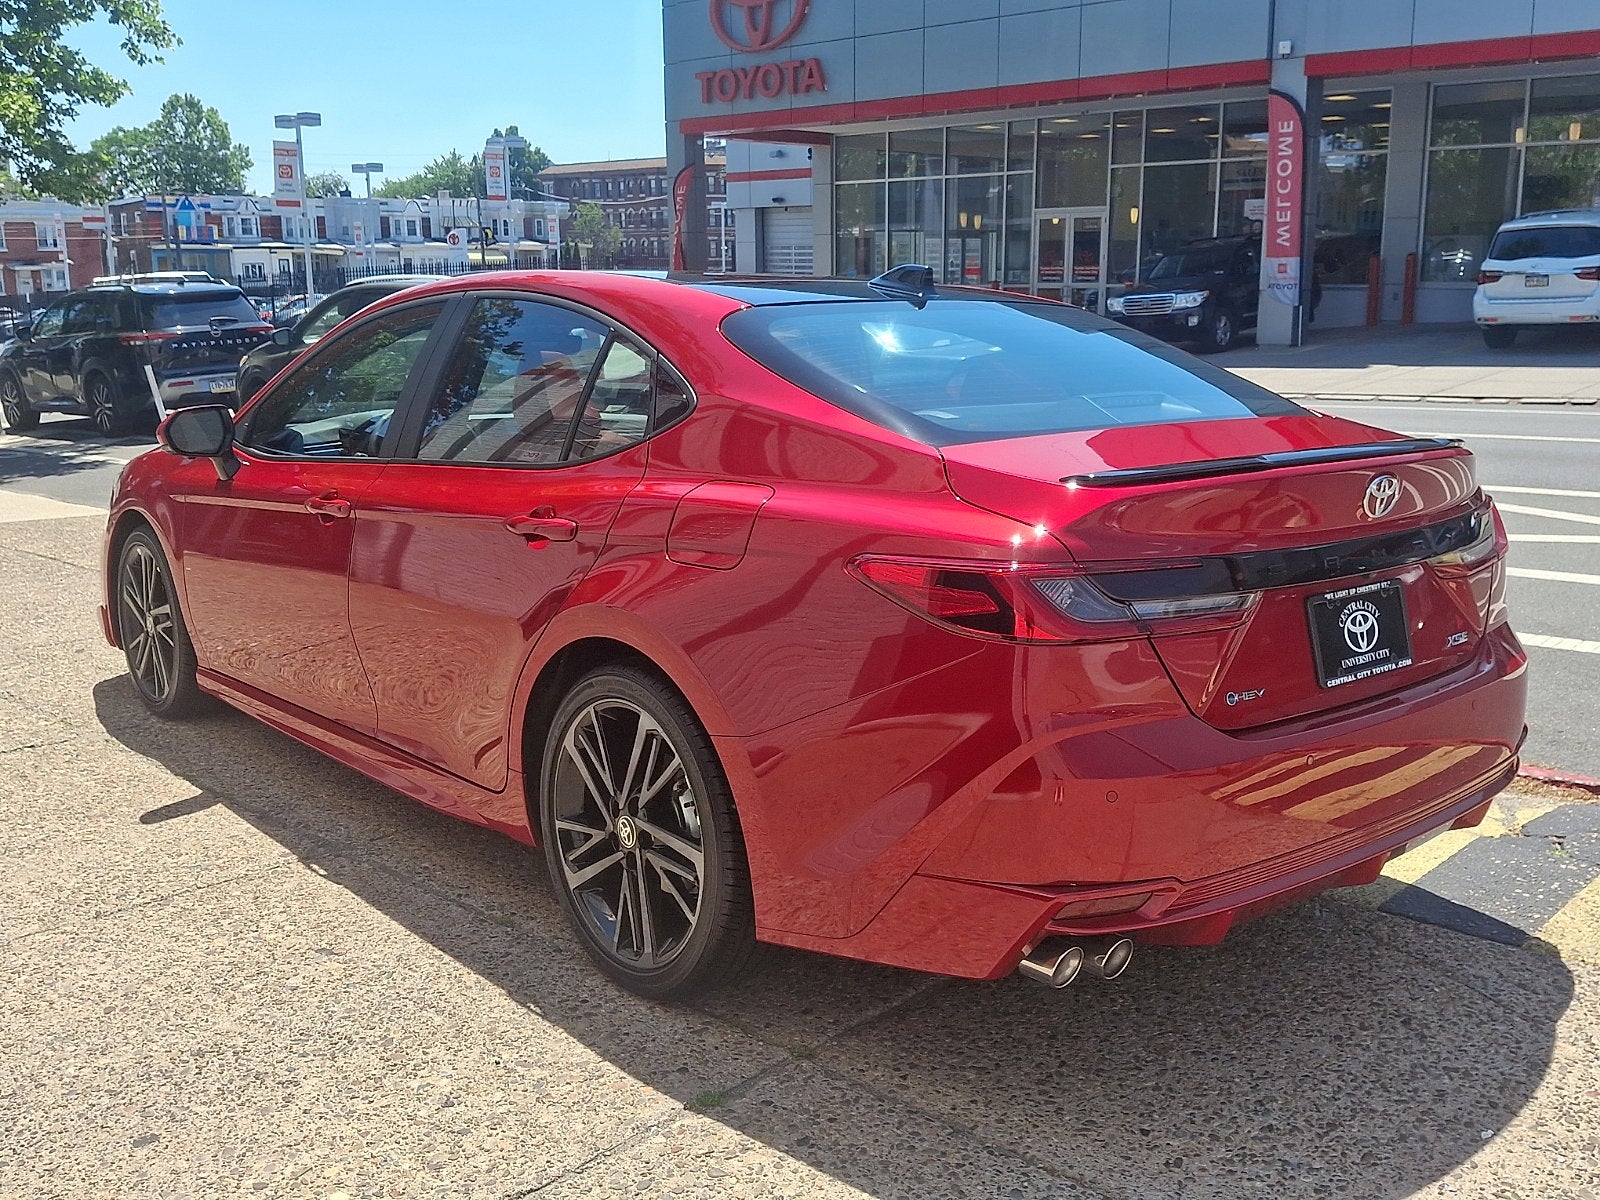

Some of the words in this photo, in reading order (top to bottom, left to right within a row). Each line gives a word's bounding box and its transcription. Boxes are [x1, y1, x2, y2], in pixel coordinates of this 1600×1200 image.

[695, 58, 826, 104] TOYOTA
[170, 336, 258, 349] PATHFINDER
[1338, 600, 1364, 627] CENTRAL
[1365, 601, 1381, 618] CITY
[1341, 651, 1376, 669] UNIVERSITY
[1376, 648, 1391, 659] CITY
[1327, 674, 1356, 688] CENTRAL
[1357, 670, 1371, 679] CITY
[1372, 663, 1396, 675] TOYOTA
